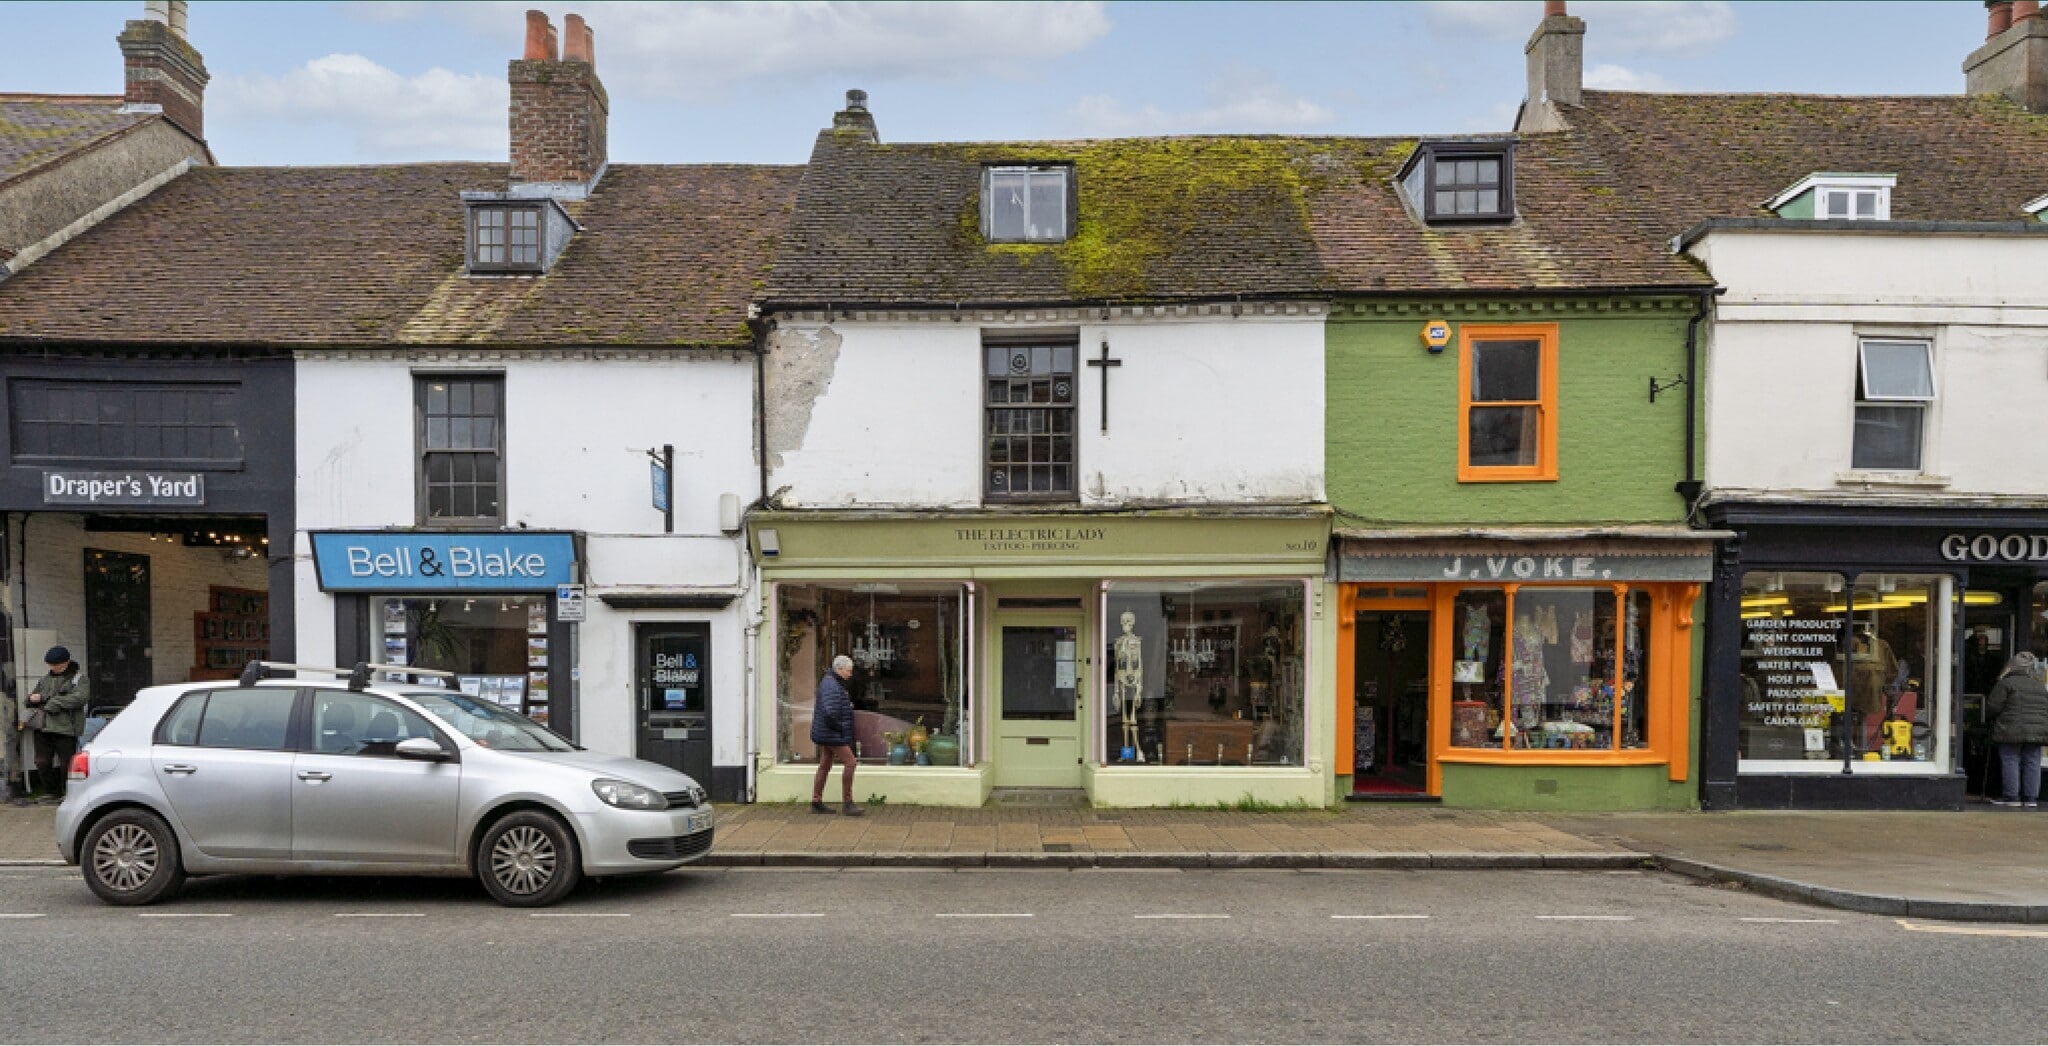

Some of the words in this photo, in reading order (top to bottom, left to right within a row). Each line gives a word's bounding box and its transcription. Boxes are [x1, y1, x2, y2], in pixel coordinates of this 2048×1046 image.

[50, 475, 142, 501] Draper's
[148, 475, 197, 497] Yard
[955, 529, 987, 540] THE
[990, 529, 1062, 540] ELECTRIC
[1065, 529, 1106, 540] LADY
[983, 542, 1025, 551] TATTOO
[1031, 542, 1080, 551] PIERCING
[348, 547, 412, 577] Bell
[419, 547, 445, 577] &
[450, 547, 545, 577] Blake
[1747, 620, 1787, 629] GARDEN
[1789, 620, 1842, 629] PRODUCTS
[1749, 634, 1789, 642] RODENT
[1791, 634, 1838, 642] CONTROL
[1762, 648, 1824, 657] WEEDKILLER
[656, 653, 683, 669] Bell
[685, 653, 697, 669] &
[1757, 662, 1791, 671] WATER
[656, 669, 698, 683] Blake
[1767, 676, 1793, 685] HOSE
[1767, 689, 1820, 698] PADLOCK
[1747, 703, 1784, 712] SAFETY
[1763, 717, 1797, 726] CALOR
